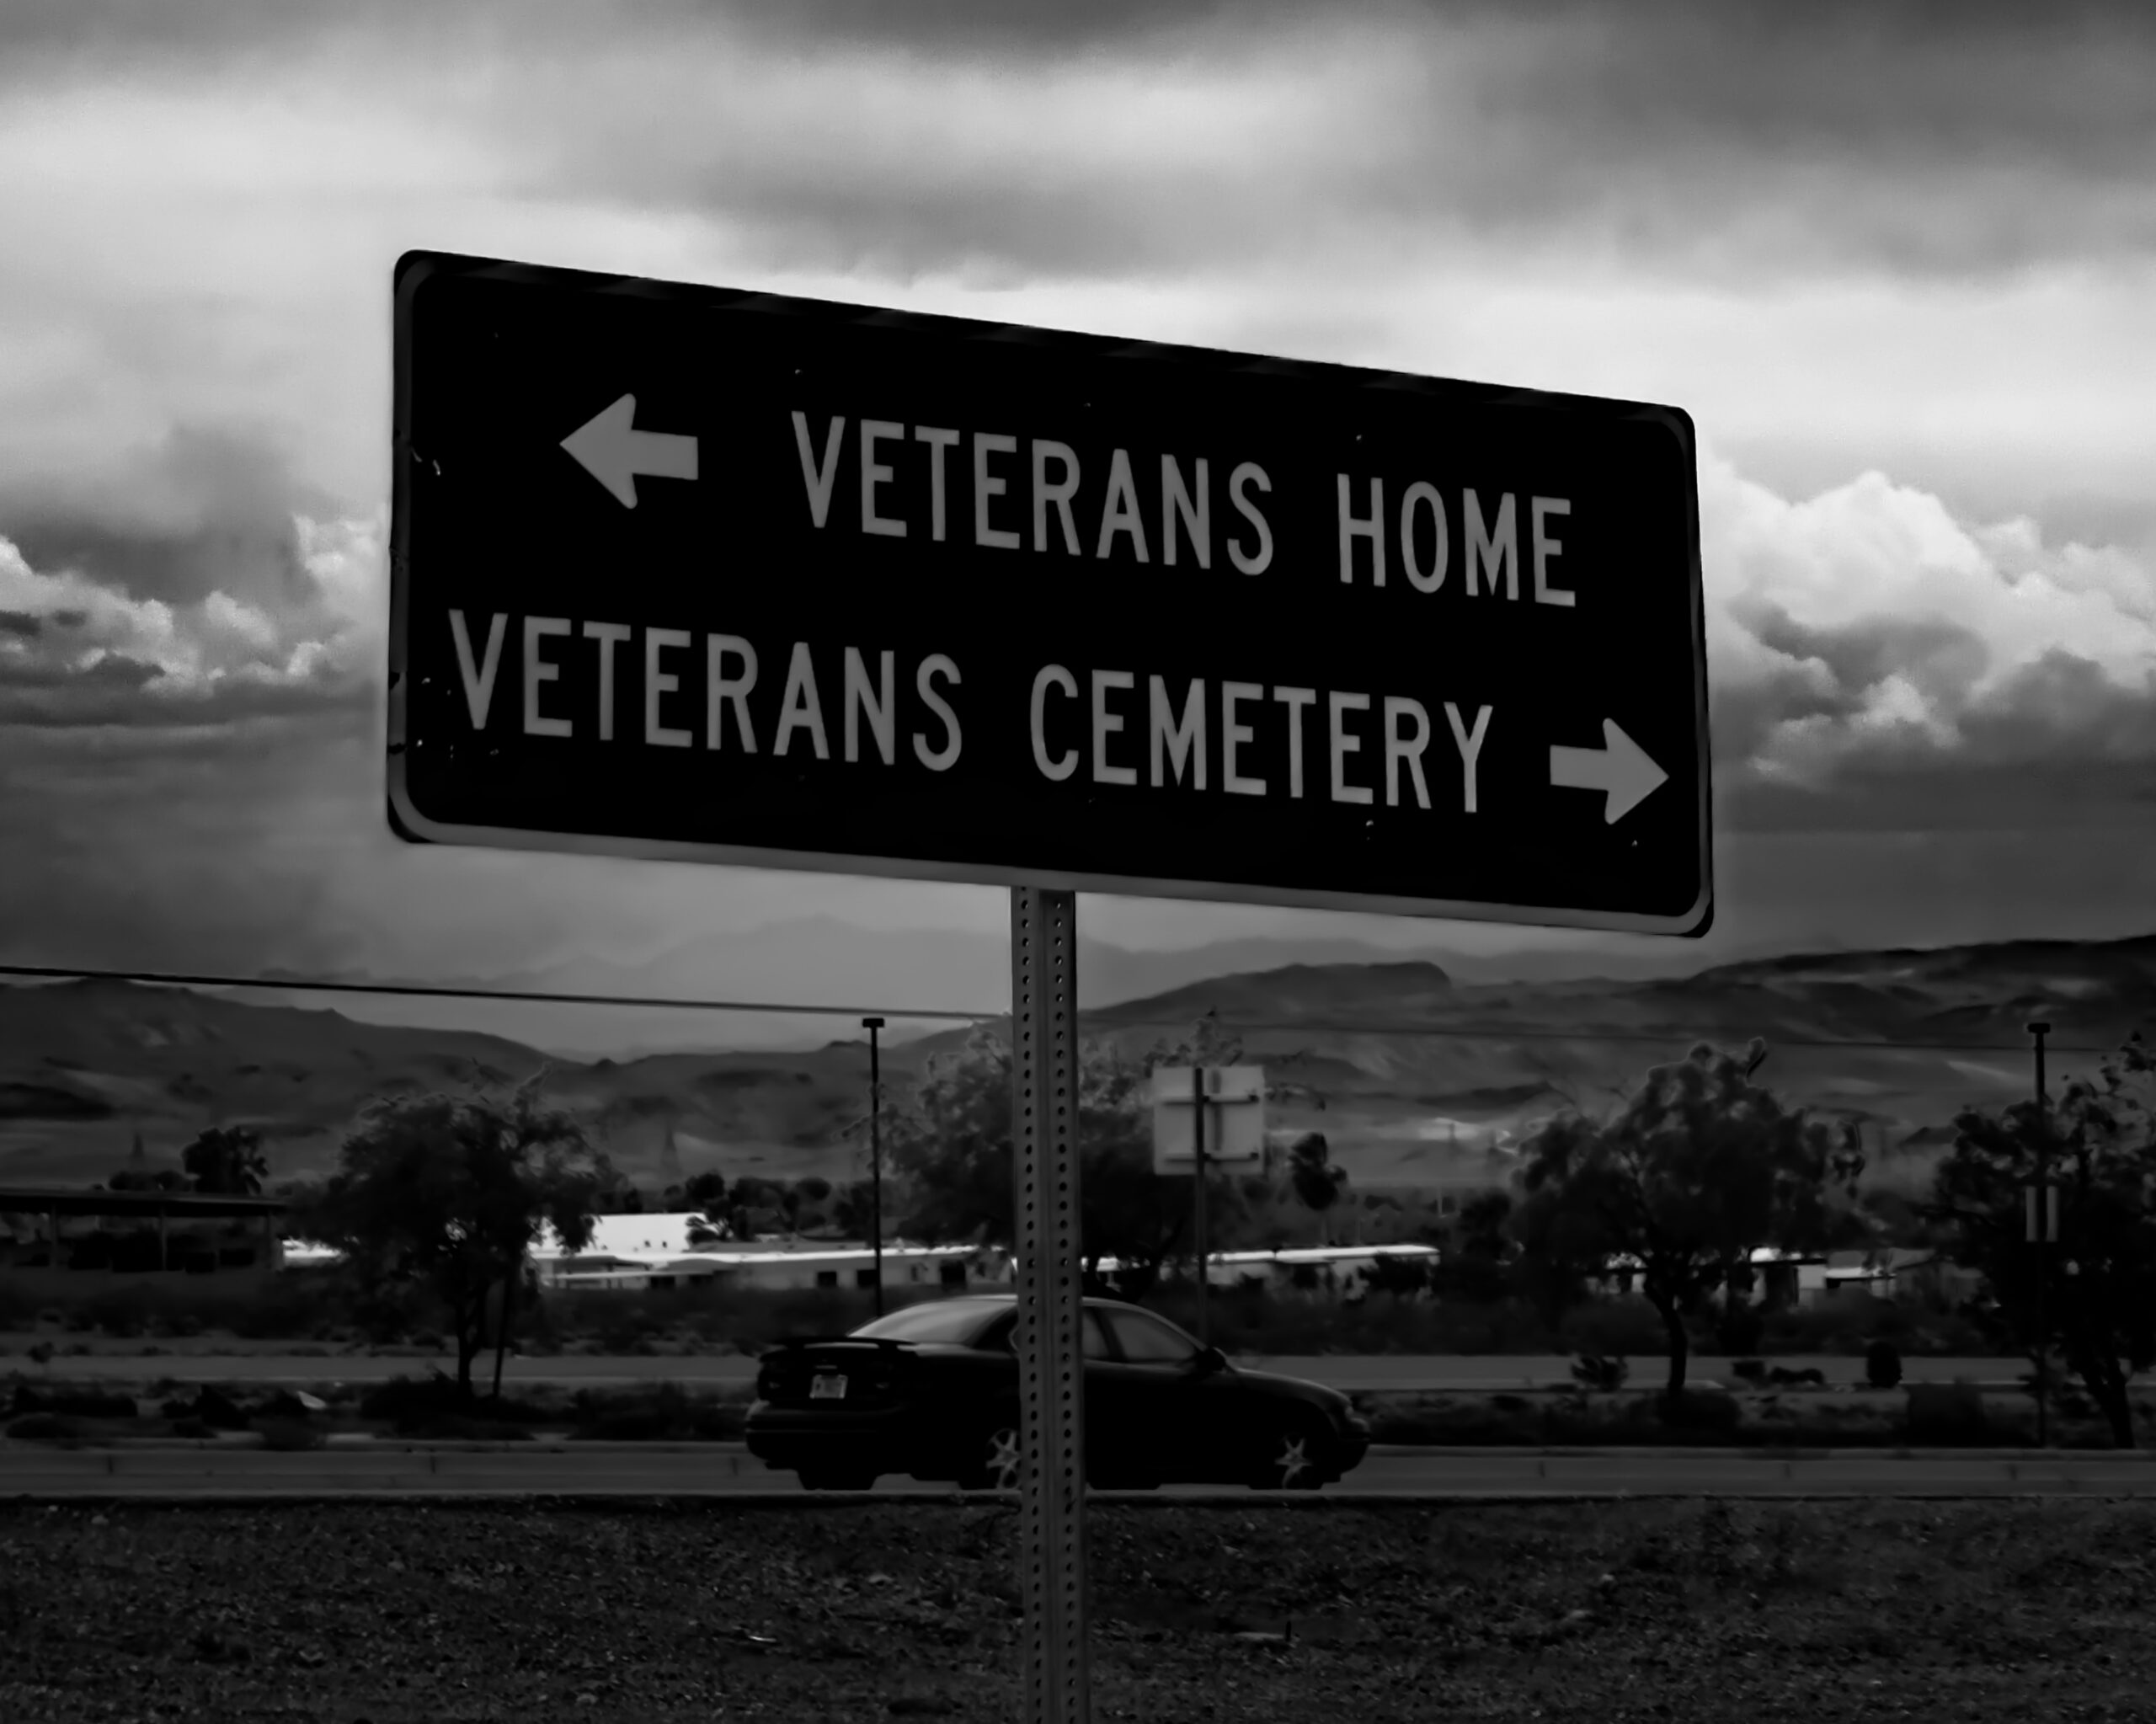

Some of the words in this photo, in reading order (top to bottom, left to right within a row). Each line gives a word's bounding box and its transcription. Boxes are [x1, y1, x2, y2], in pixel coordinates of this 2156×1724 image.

[792, 411, 1273, 575] VETERANS
[1337, 473, 1576, 606] HOME
[451, 611, 962, 771] VETERANS
[1031, 665, 1493, 814] CEMETERY
